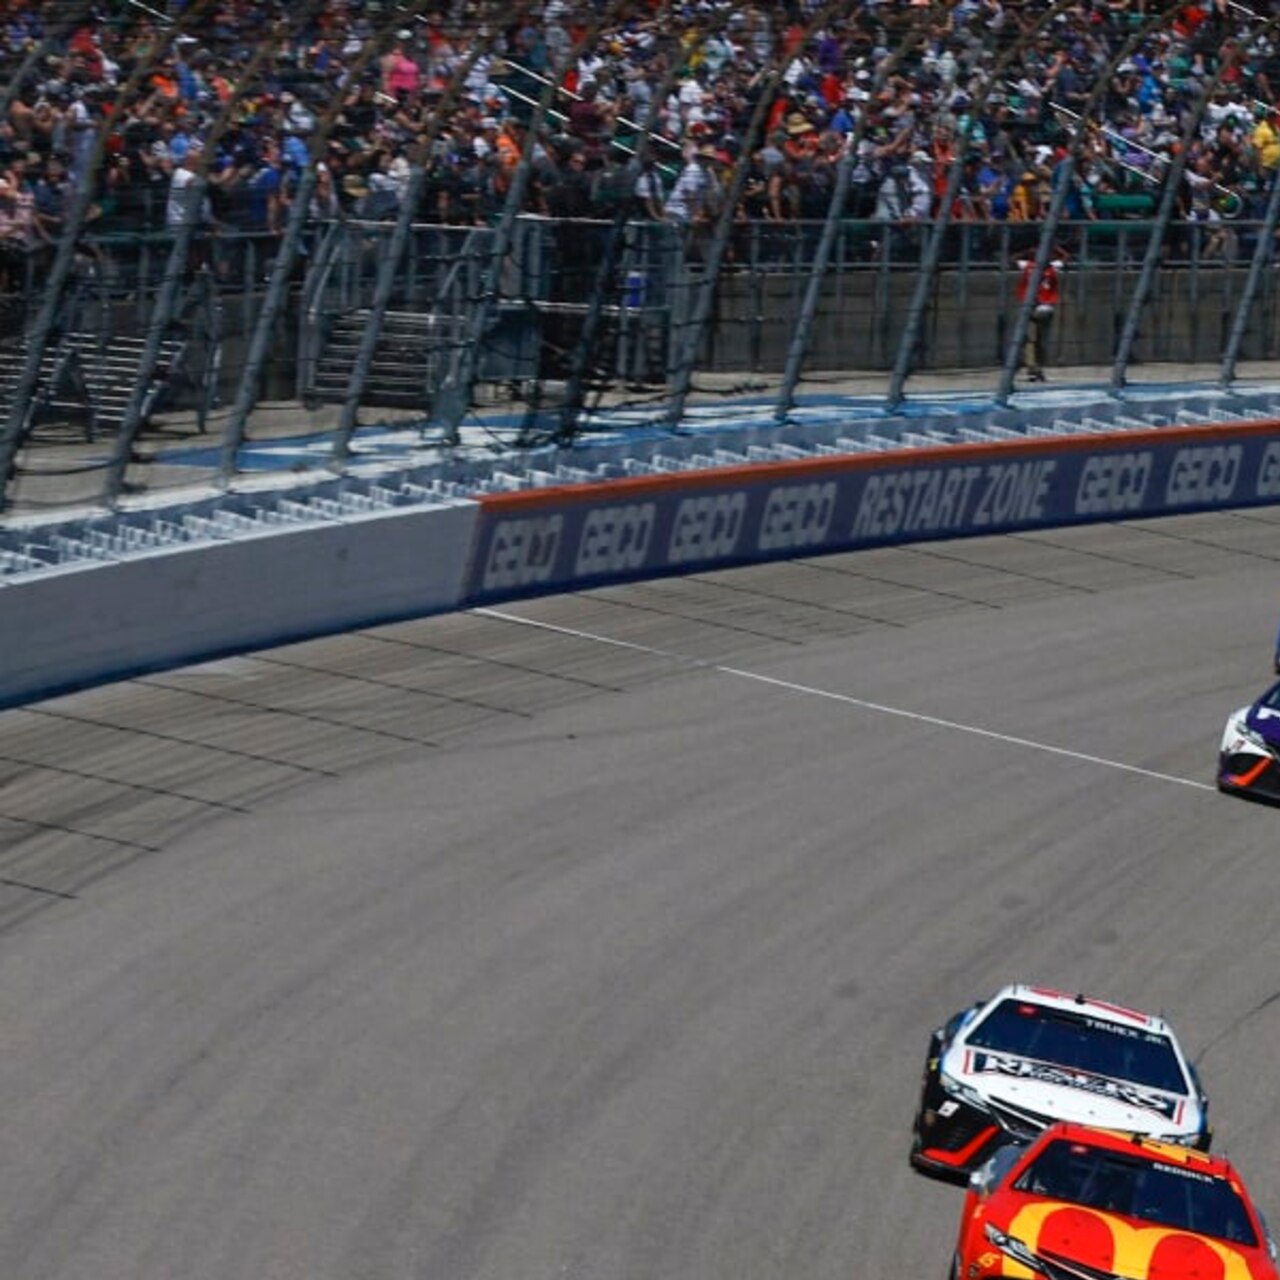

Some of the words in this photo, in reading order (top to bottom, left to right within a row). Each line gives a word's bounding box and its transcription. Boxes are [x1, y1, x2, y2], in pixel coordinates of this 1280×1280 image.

[482, 514, 563, 589] GEICO
[574, 501, 656, 575] GEICO
[668, 491, 747, 561] GEICO
[758, 483, 837, 550] GEICO
[853, 466, 980, 540] RESTART
[974, 459, 1057, 526] ZONE
[1075, 452, 1154, 515] GEICO
[1167, 444, 1243, 504] GEICO
